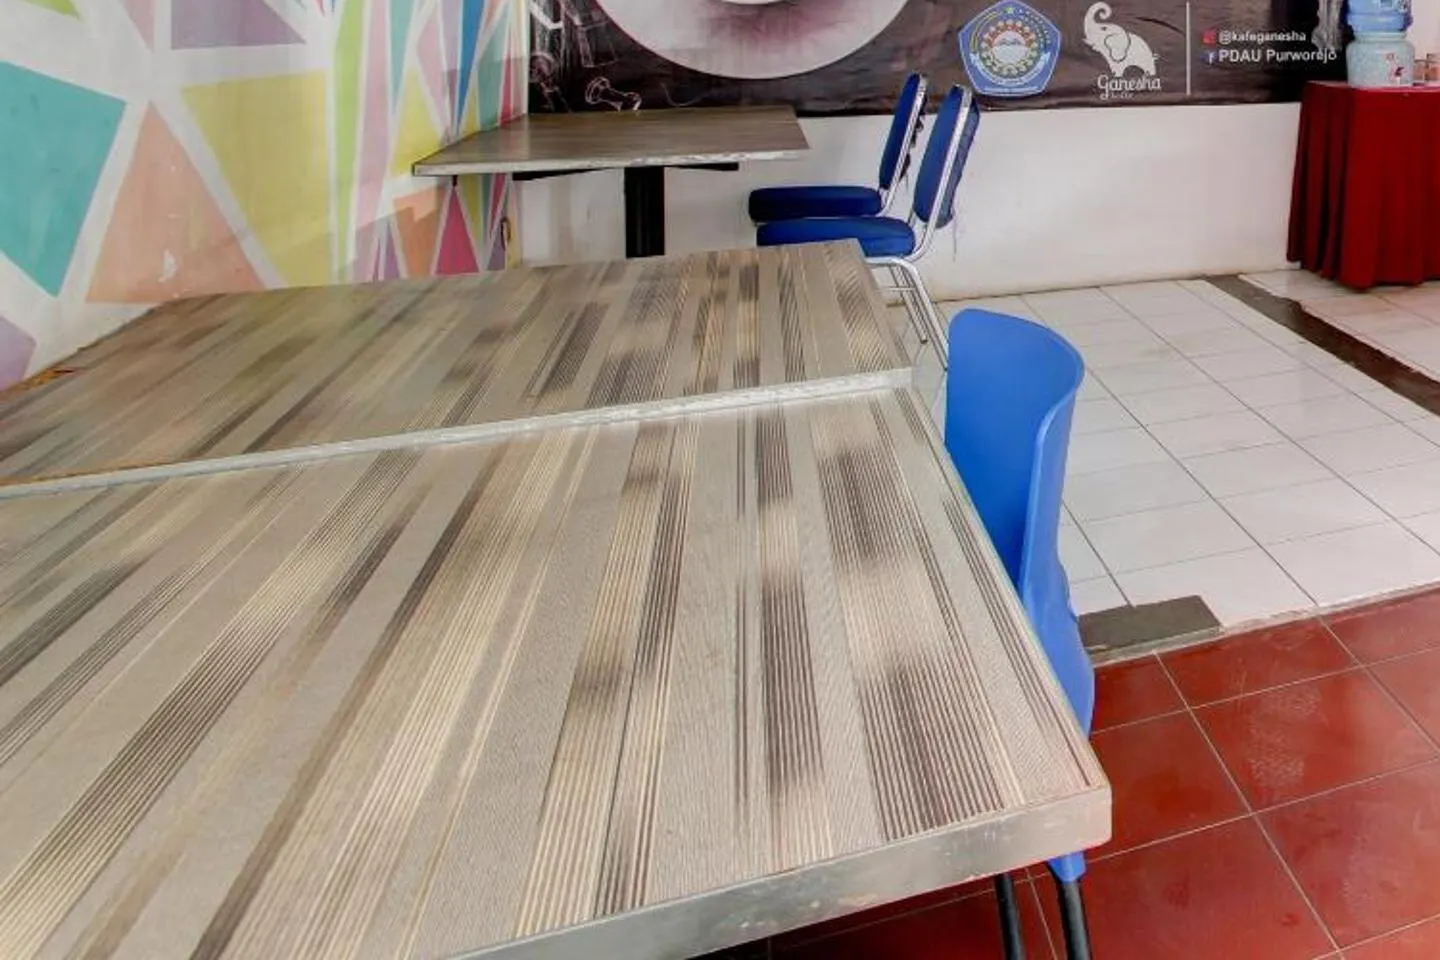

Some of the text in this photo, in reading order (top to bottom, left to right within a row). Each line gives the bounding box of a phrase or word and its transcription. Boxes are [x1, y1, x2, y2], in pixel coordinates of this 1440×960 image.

[1219, 30, 1307, 45] @kafeganesha
[1219, 48, 1261, 62] PDAU
[1266, 48, 1337, 64] Purworejo
[1097, 74, 1161, 101] Ganesha
